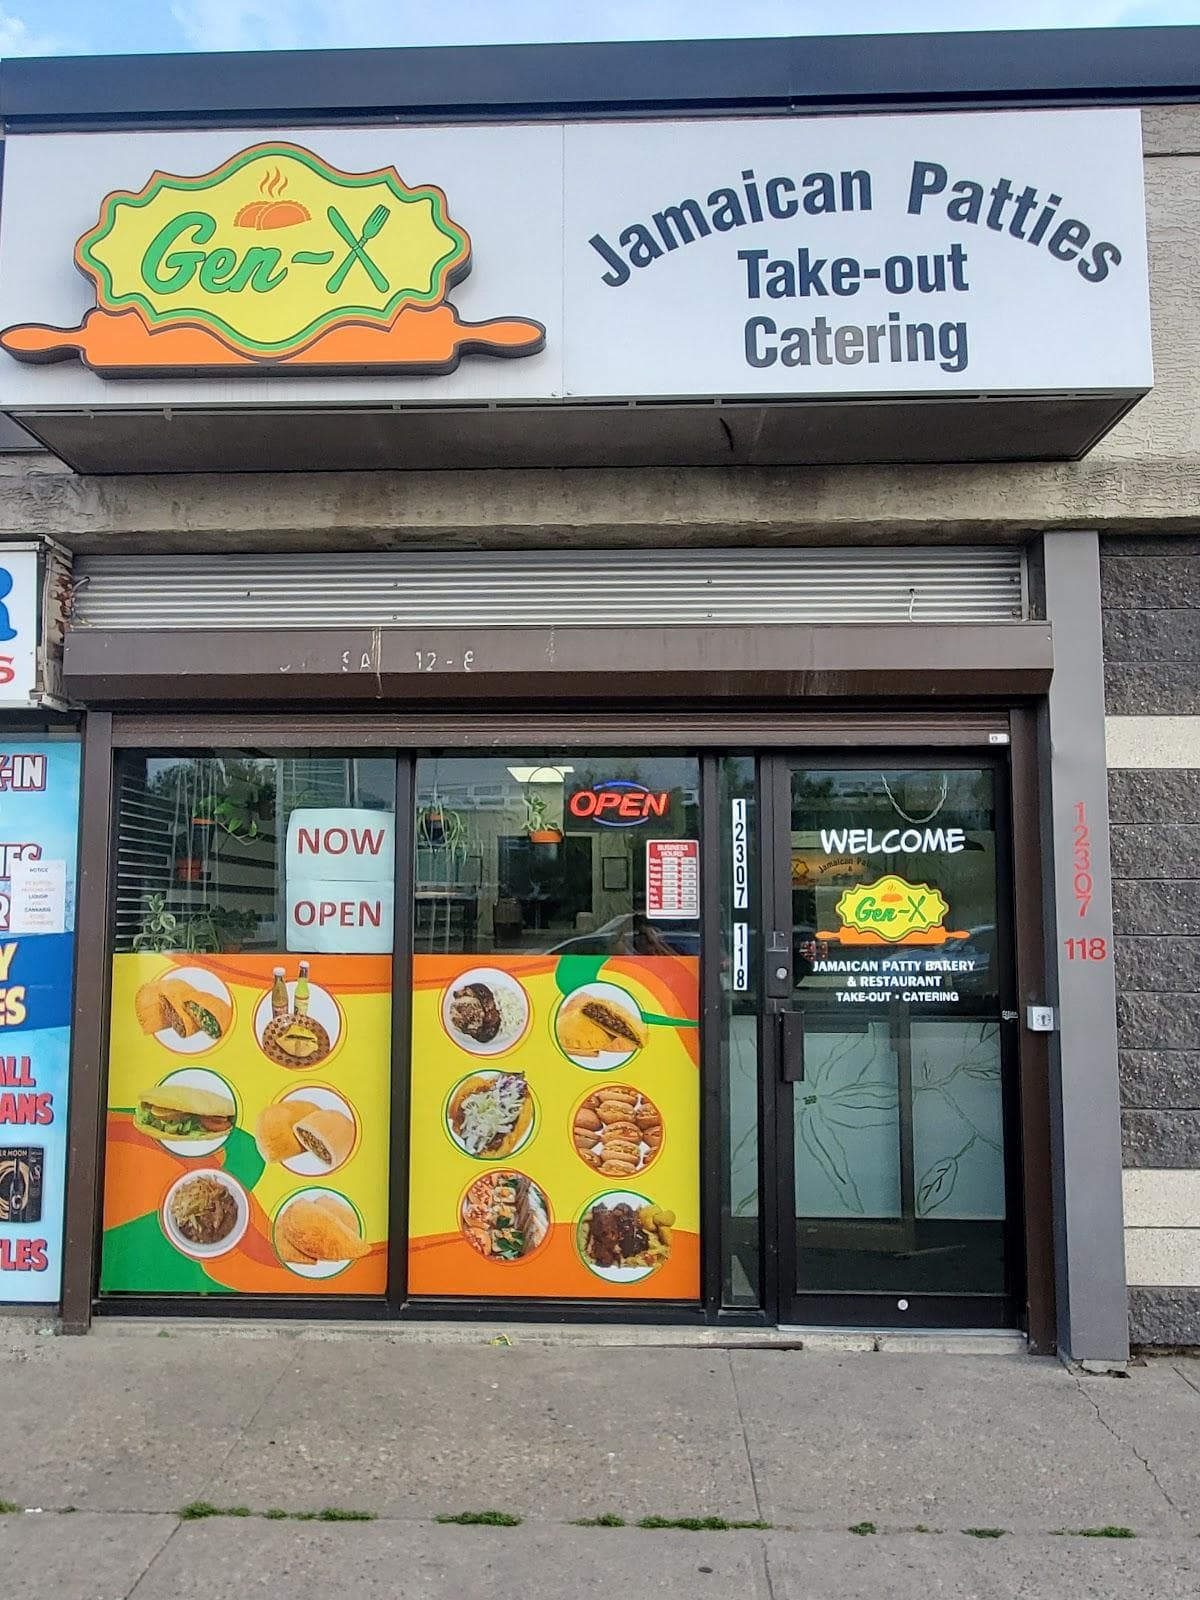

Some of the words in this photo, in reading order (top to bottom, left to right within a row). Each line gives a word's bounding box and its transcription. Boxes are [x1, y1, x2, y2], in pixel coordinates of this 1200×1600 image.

[588, 168, 872, 288] Jamaican
[907, 160, 1122, 283] Patties
[141, 204, 390, 294] Gen-X
[738, 243, 969, 299] Take-out
[744, 312, 969, 373] Catering
[570, 791, 667, 817] OPEN
[298, 828, 385, 855] NOW
[735, 800, 745, 907] 12307
[820, 828, 966, 854] WELCOME
[1073, 802, 1093, 918] 12307
[294, 900, 381, 927] OPEN
[855, 895, 928, 923] Gen-X
[737, 924, 745, 989] 118
[1064, 937, 1107, 961] 118
[812, 960, 879, 972] JAMAICAN
[882, 960, 921, 972] PATTY
[925, 960, 975, 972] BAKERY
[847, 976, 856, 987] &
[860, 976, 942, 987] RESTAURANT
[836, 992, 891, 1002] TAKE-OUT
[902, 992, 959, 1002] CATERING
